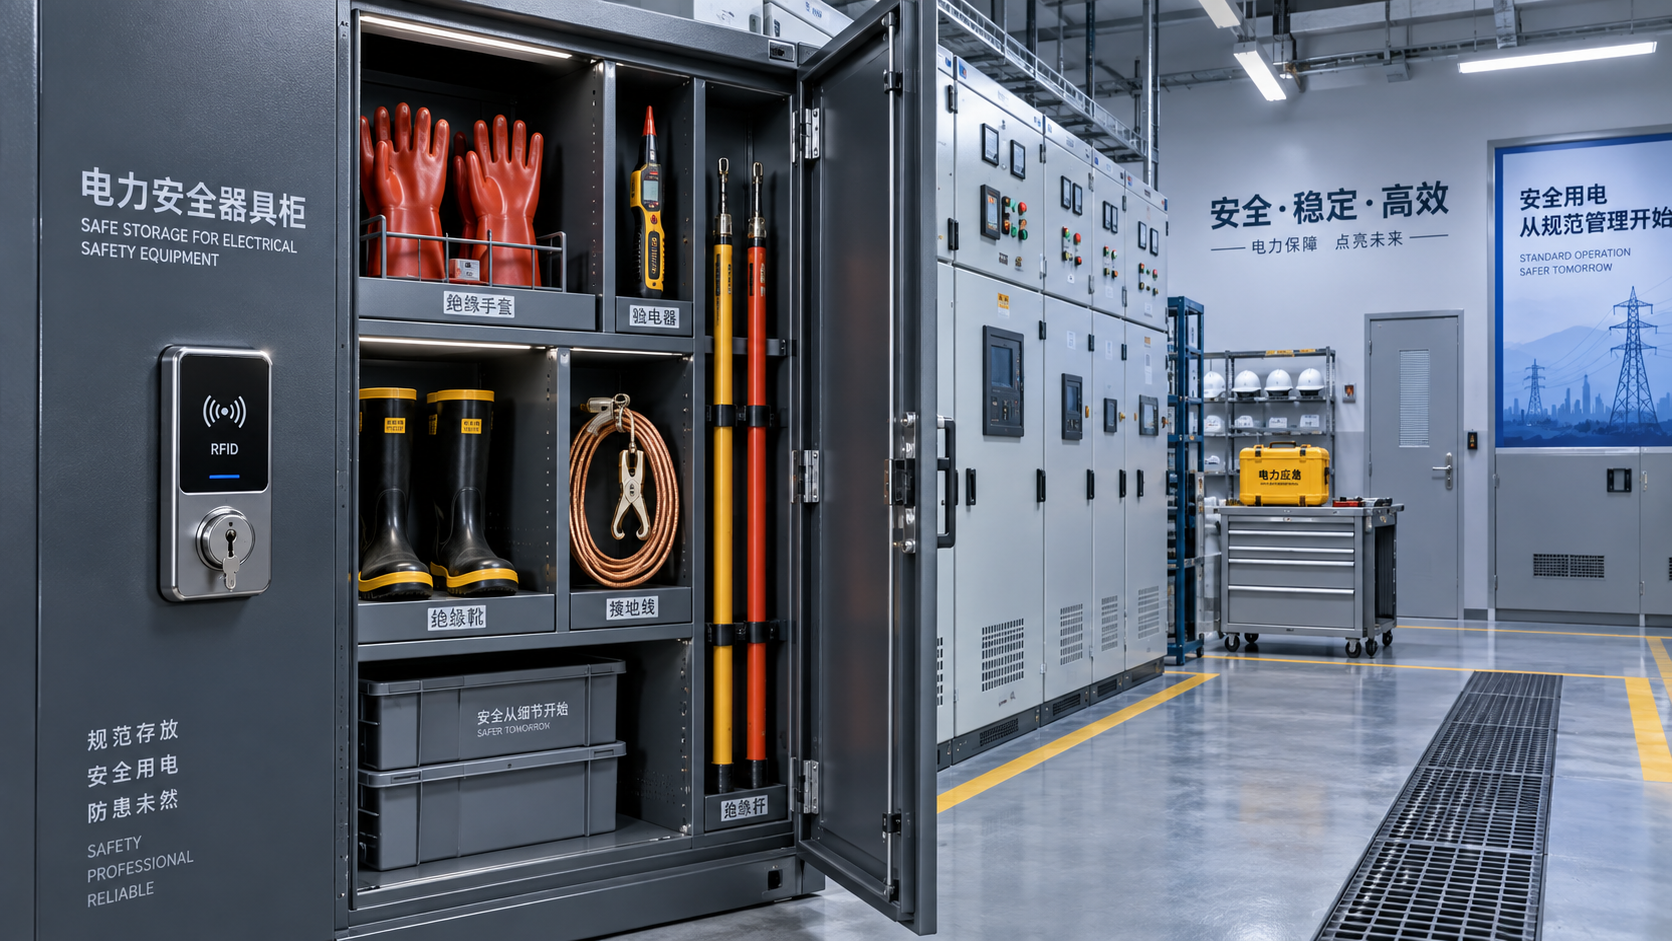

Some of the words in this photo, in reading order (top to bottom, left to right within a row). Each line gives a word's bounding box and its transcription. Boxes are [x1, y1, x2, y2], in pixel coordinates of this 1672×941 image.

[82, 167, 306, 229] 电力安全器具柜
[1520, 184, 1607, 211] 安全用电
[81, 217, 118, 235] SAFE
[123, 222, 188, 242] STORAGE
[192, 229, 219, 246] FOR
[223, 233, 297, 254] ELECTRICAL
[1520, 206, 1672, 238] 从规范管理开始
[81, 241, 135, 259] SAFETY
[140, 247, 219, 267] EQUIPMENT
[1252, 235, 1318, 255] 电力保障
[1335, 230, 1403, 250] 点亮未来
[1520, 251, 1572, 263] STANDARD
[1574, 247, 1631, 260] OPERATION
[1520, 266, 1550, 276] SAFER
[1552, 263, 1613, 275] TOMORROW
[211, 443, 239, 456] RFID
[477, 701, 569, 725] 安全从细节开始
[87, 719, 179, 751] 规范存放
[477, 727, 503, 738] SAFER
[87, 754, 179, 788] 安全用电
[87, 788, 179, 824] 防患未然
[87, 835, 142, 859] SAFETY
[87, 850, 194, 883] PROFESSIONAL
[87, 881, 155, 908] RELIABLE
